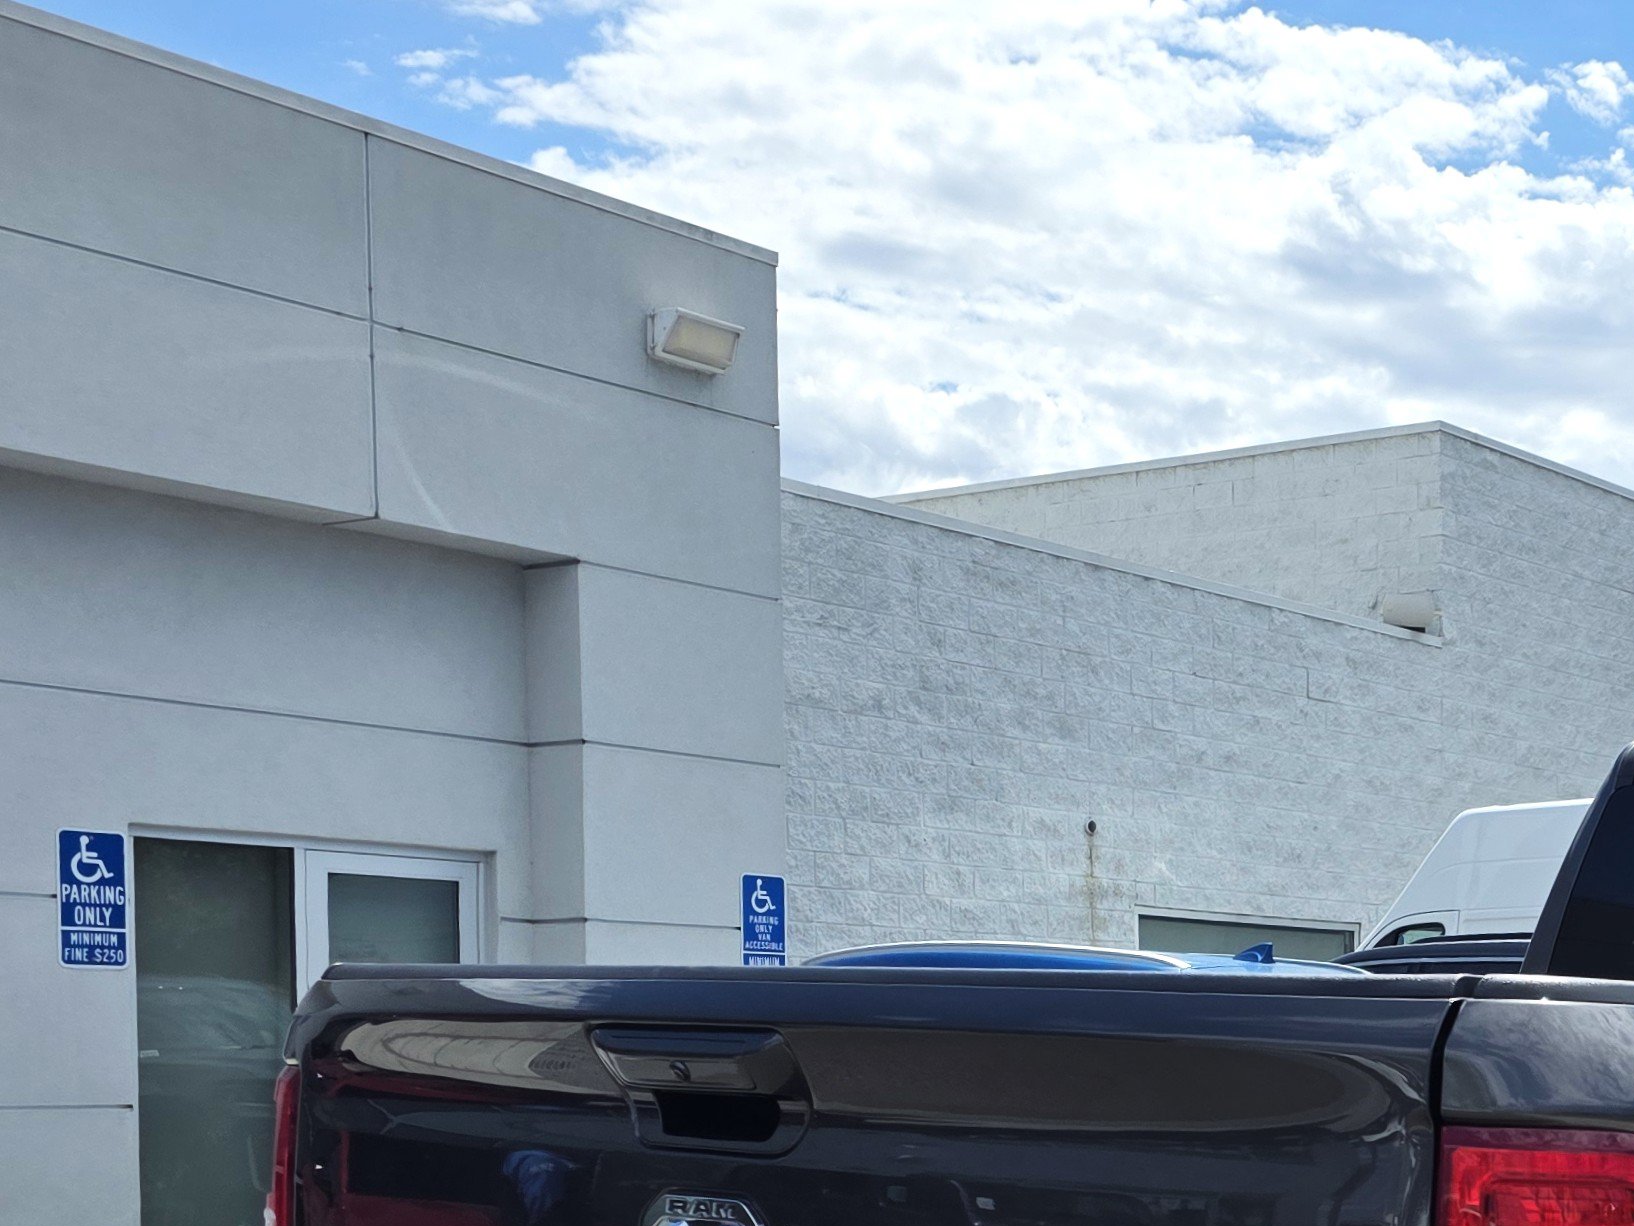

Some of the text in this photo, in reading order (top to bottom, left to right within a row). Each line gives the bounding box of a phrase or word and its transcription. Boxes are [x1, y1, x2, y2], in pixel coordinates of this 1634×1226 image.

[61, 883, 125, 906] PARKING
[74, 905, 113, 926] ONLY
[749, 915, 779, 926] PARKING
[755, 924, 773, 933] ONLY
[70, 932, 118, 947] MINIMUM
[758, 933, 771, 941] VAN
[745, 940, 783, 950] ACCESSIBLE
[64, 947, 124, 963] FINE $250
[665, 1198, 736, 1220] RAM
